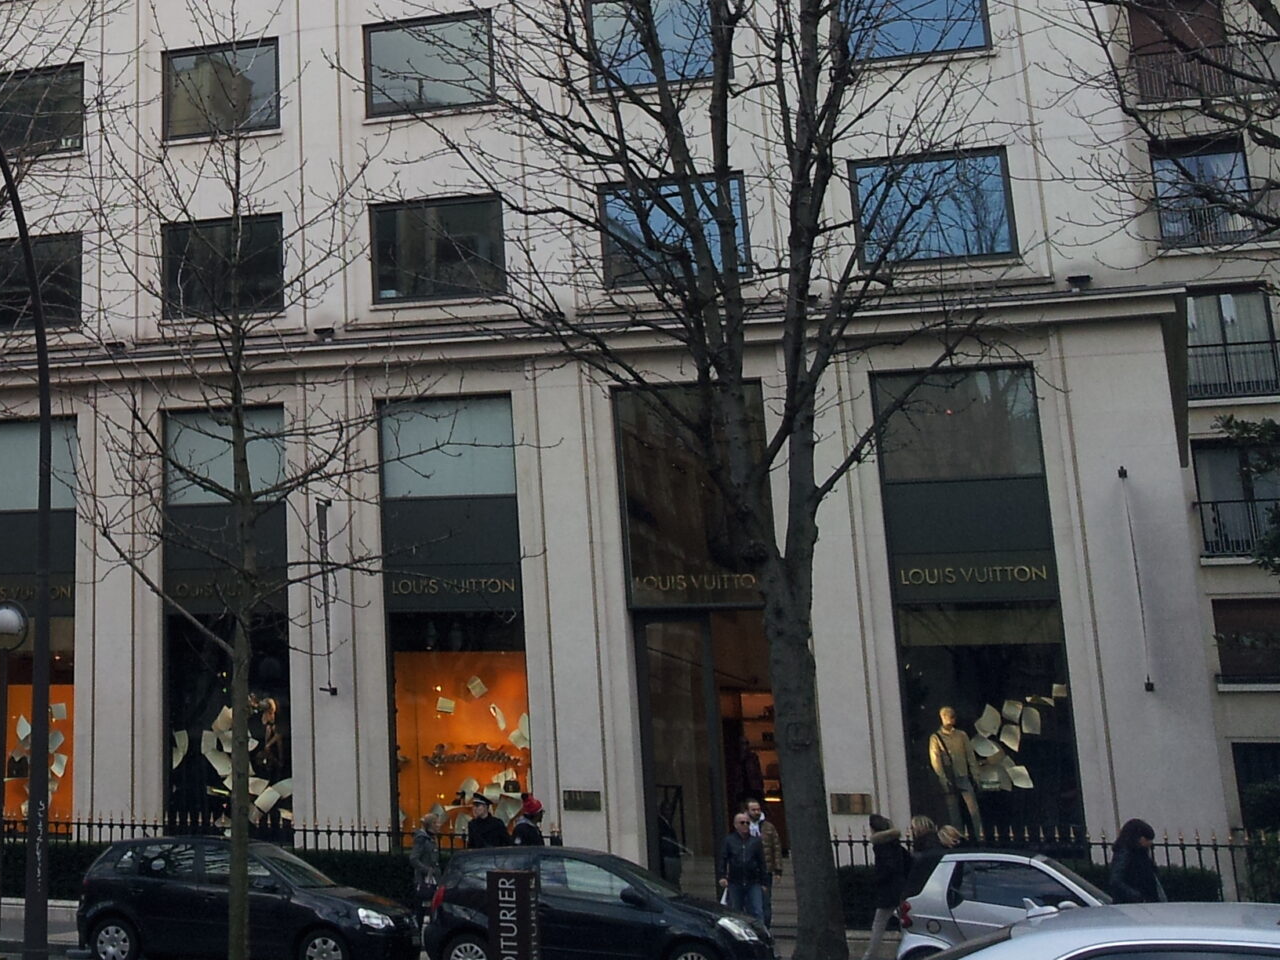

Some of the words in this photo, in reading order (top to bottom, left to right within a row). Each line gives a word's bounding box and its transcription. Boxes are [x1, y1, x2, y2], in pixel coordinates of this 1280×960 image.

[689, 572, 757, 590] VUITTO
[901, 568, 956, 584] LOUIS
[959, 564, 1047, 582] VUITTON
[392, 579, 439, 594] LOUIS
[441, 578, 516, 594] VUITTON
[498, 878, 519, 960] ITURIER
